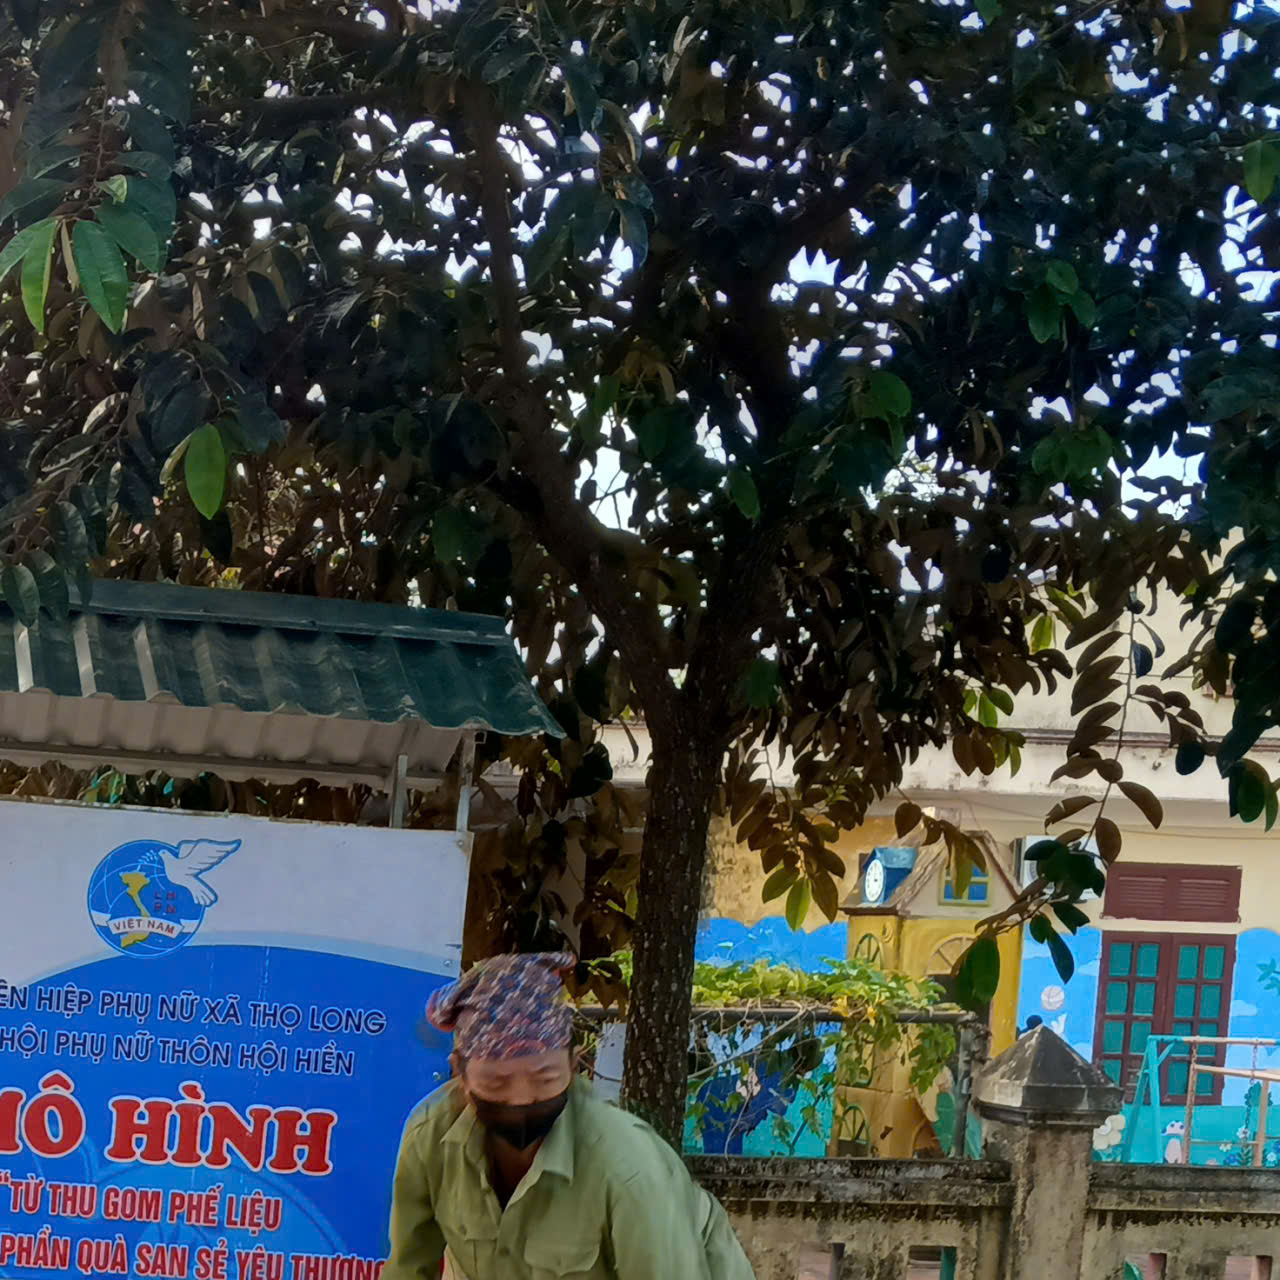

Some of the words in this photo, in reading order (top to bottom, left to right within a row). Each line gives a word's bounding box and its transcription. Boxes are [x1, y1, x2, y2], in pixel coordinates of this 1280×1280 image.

[147, 920, 176, 934] NAM
[36, 982, 93, 1018] HIỆP
[99, 990, 150, 1023] PHỤ
[158, 990, 199, 1022] NỮ
[202, 994, 241, 1025] XÃ
[249, 1001, 302, 1035] THỌ
[309, 1005, 387, 1035] LONG
[54, 1031, 106, 1064] PHỤ
[113, 1030, 154, 1062] NỮ
[159, 1035, 231, 1067] THÔN
[238, 1040, 287, 1076] HỘI
[295, 1040, 354, 1076] HIỀN
[106, 1082, 337, 1175] HÌNH
[48, 1183, 97, 1217] THU
[103, 1186, 162, 1223] GOM
[168, 1183, 223, 1227] PHẾ
[225, 1189, 282, 1236] LIỆU
[0, 1222, 70, 1268] PHẦN
[76, 1233, 128, 1274] QUÀ
[135, 1242, 188, 1278] SAN
